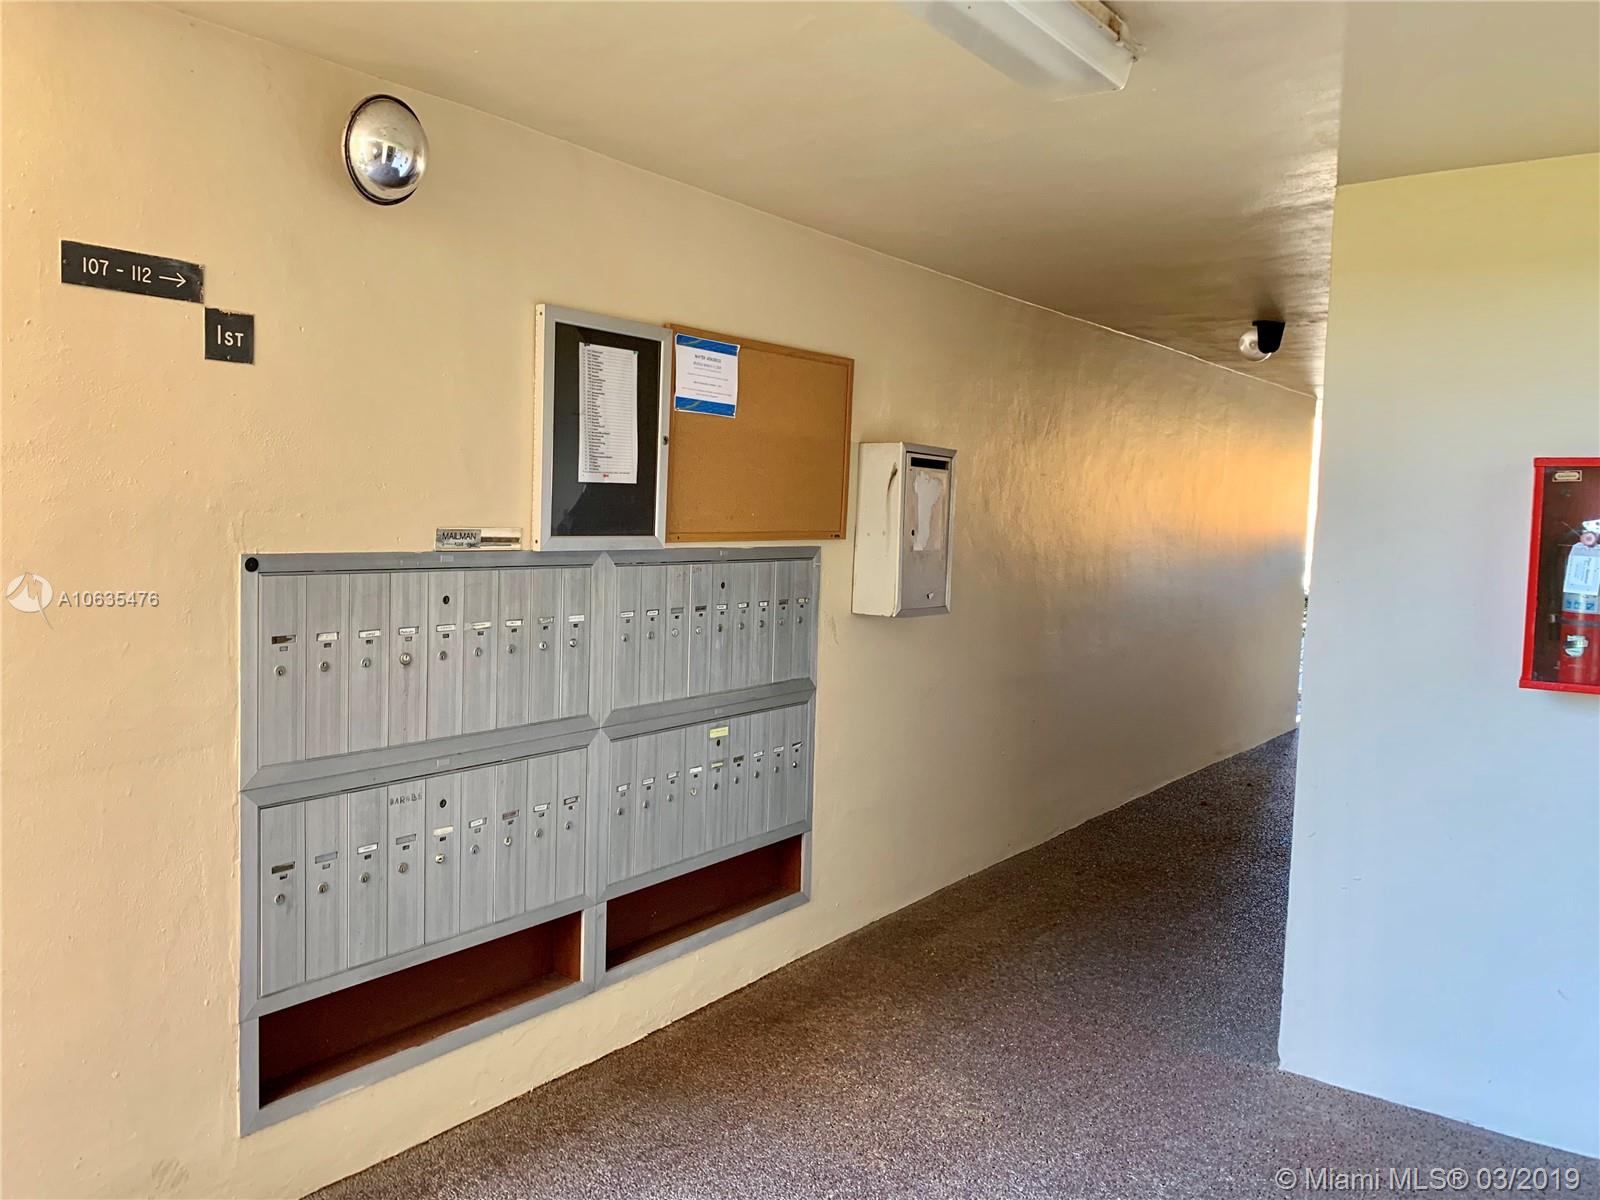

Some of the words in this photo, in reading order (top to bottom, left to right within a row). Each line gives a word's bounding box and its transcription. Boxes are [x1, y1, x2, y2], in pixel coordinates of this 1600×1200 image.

[82, 256, 109, 276] 107
[131, 265, 152, 283] 112
[441, 531, 477, 541] MAILMAN
